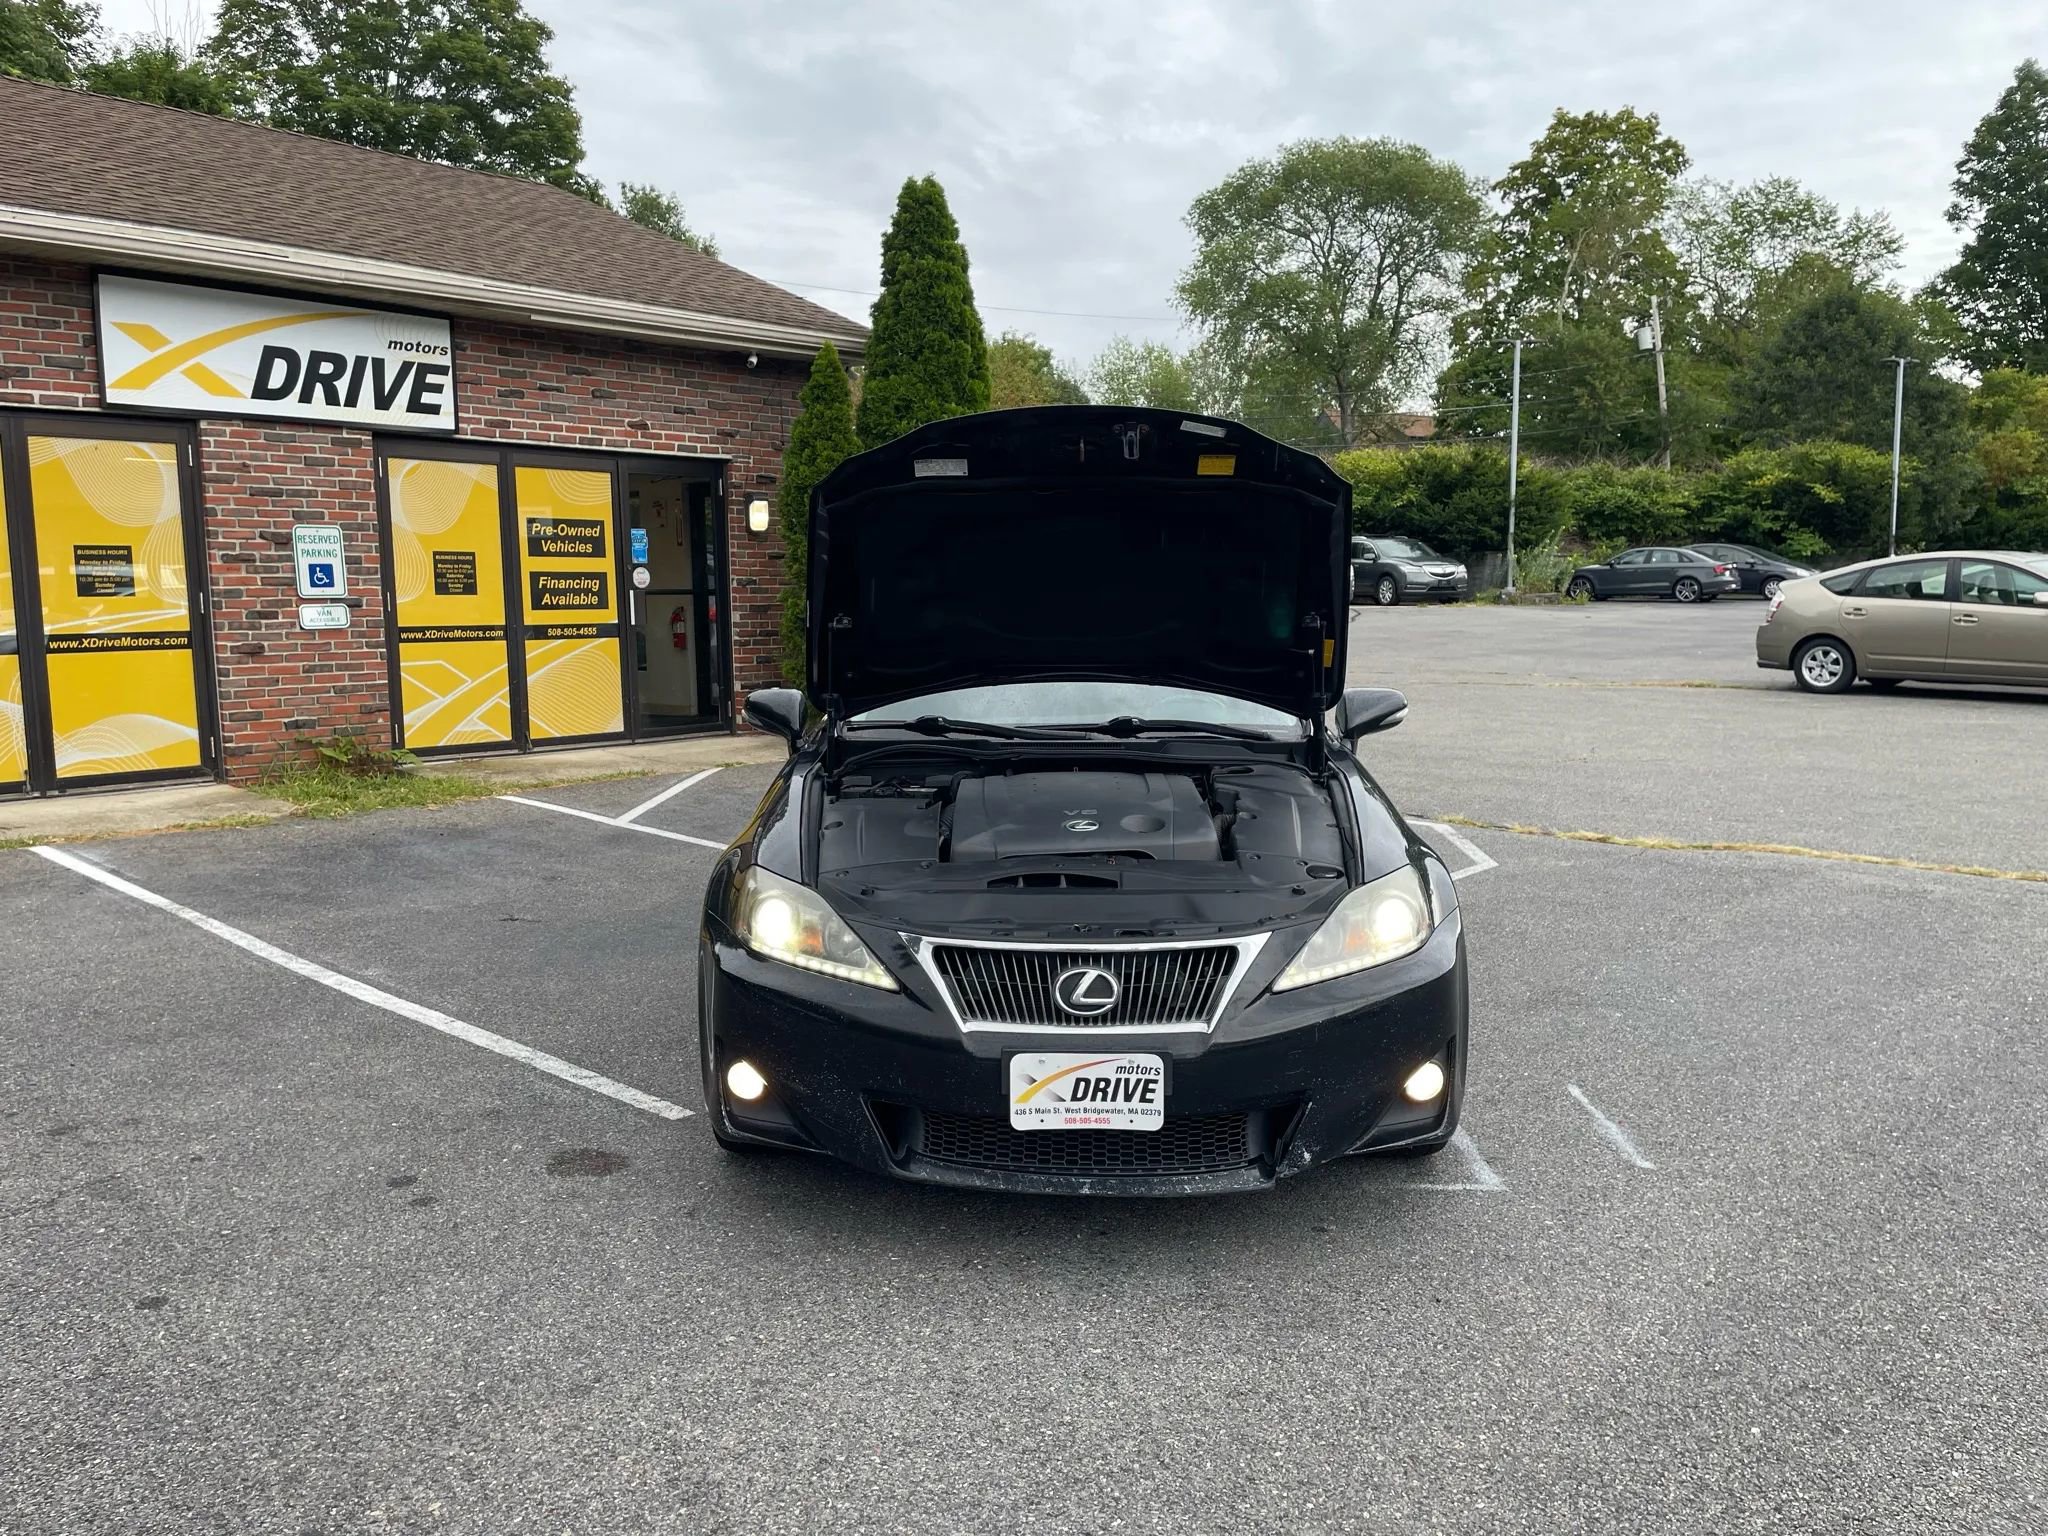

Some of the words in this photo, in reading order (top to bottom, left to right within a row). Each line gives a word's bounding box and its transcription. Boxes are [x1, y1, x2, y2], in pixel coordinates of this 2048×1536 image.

[388, 337, 449, 356] motors
[251, 345, 450, 415] DRIVE
[532, 523, 600, 537] Pre-Owned
[297, 535, 338, 544] RESERVED
[541, 540, 593, 552] Vehicles
[301, 549, 338, 558] PARKING
[538, 576, 600, 591] Financing
[541, 593, 599, 605] Available
[400, 629, 504, 639] www.XDriveMotors.com
[548, 628, 597, 636] 508-505-4555
[49, 637, 188, 649] www.XDriveMotors.com
[1115, 1064, 1161, 1076] motors
[1070, 1077, 1159, 1104] DRIVE
[1083, 1107, 1125, 1116] Bridgewater,
[1141, 1109, 1161, 1117] 02379
[1064, 1117, 1111, 1125] 508-505-4555
